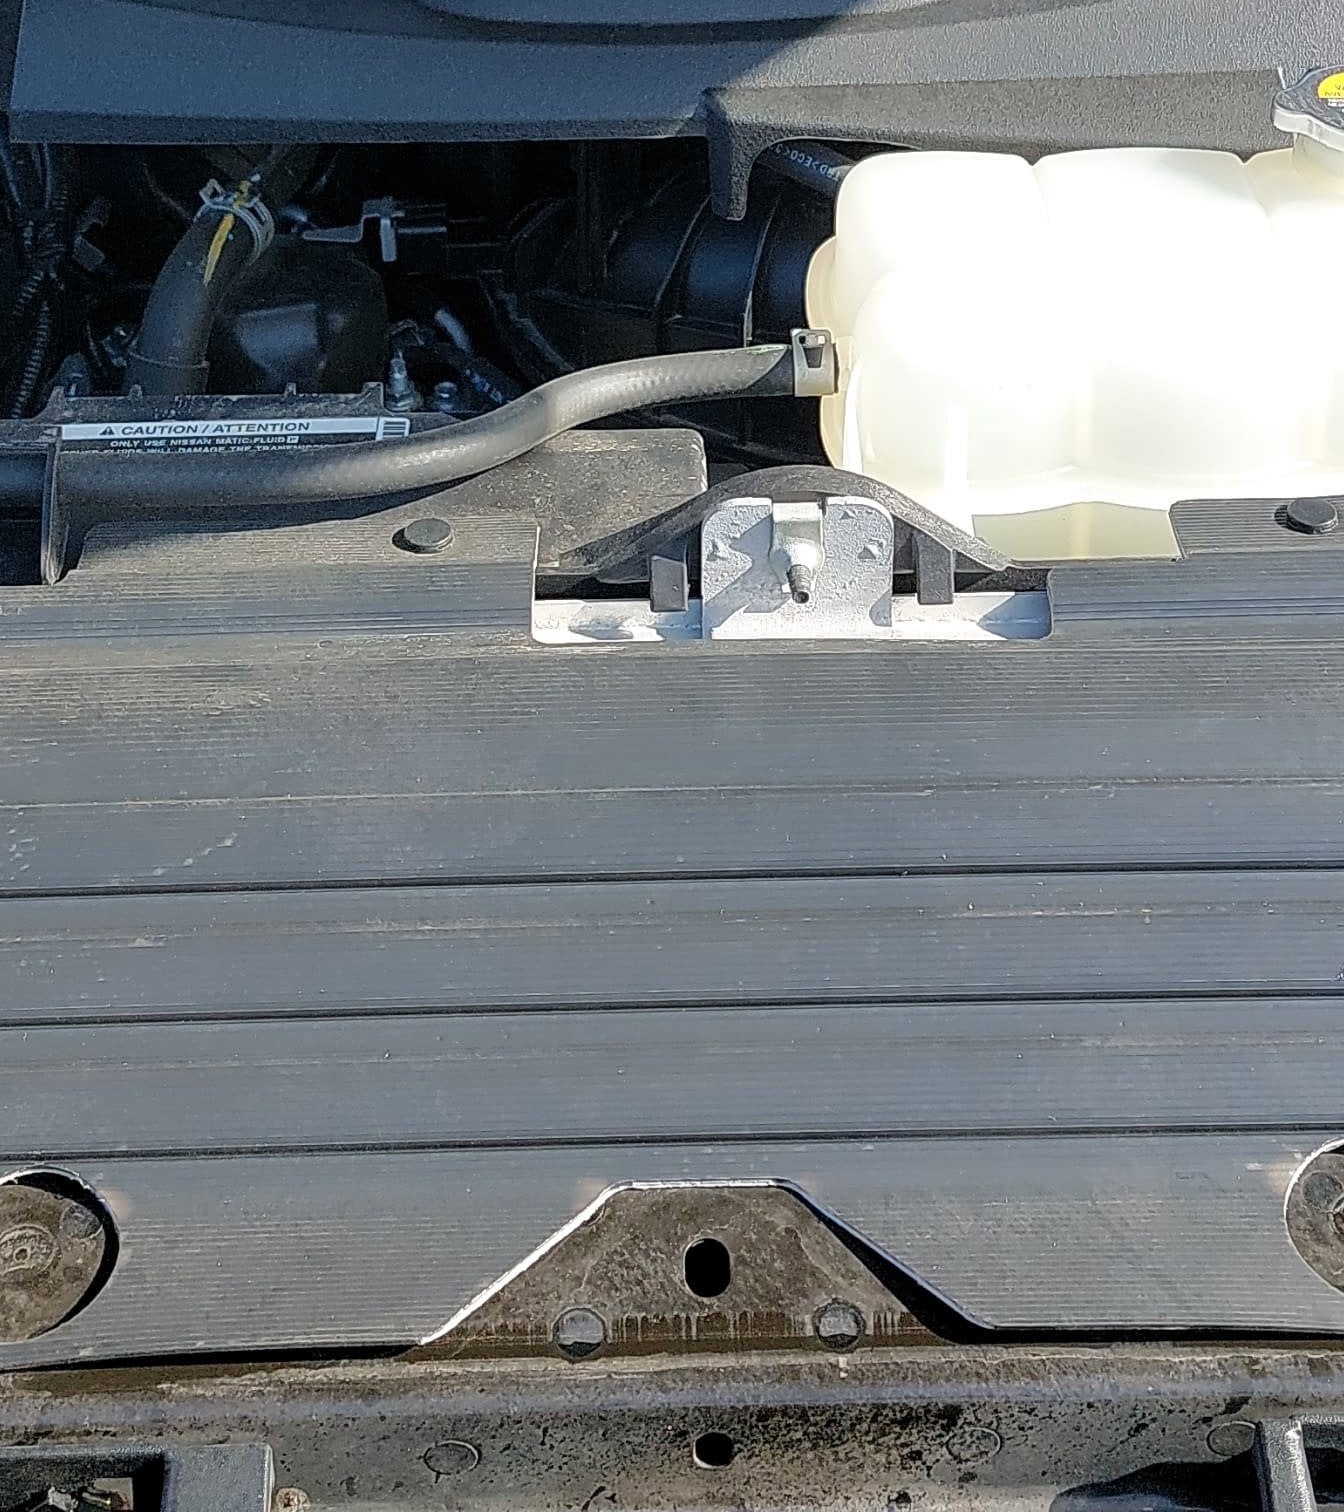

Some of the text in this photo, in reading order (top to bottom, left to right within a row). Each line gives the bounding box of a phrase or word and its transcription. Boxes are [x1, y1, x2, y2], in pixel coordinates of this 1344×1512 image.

[121, 424, 198, 435] CAUTION
[212, 422, 310, 433] ATTENTION
[110, 439, 140, 448] ONLY
[144, 439, 166, 447] USE
[170, 438, 211, 446] NISSAN
[253, 436, 285, 444] FLUID
